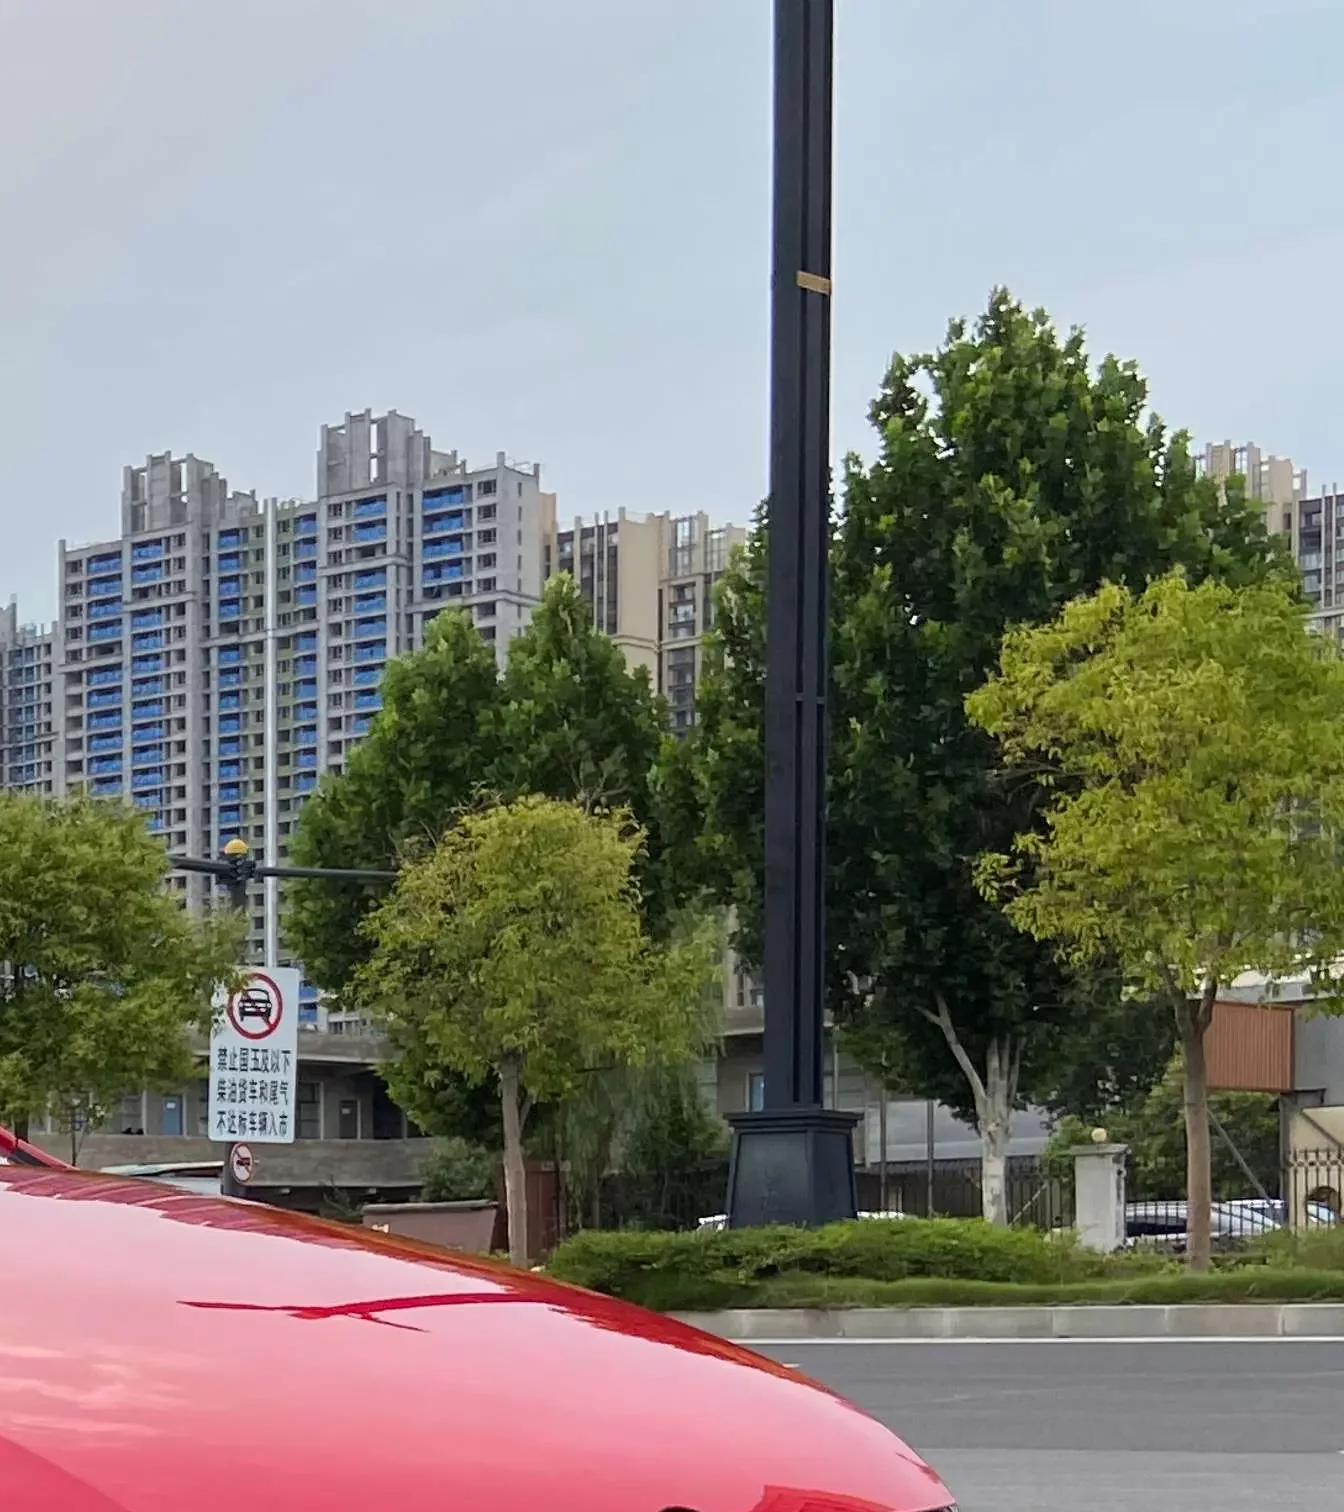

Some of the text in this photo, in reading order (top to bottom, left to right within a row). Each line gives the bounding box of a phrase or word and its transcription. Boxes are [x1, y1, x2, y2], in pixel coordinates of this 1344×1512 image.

[216, 1077, 289, 1106] 柴油货车和尾气
